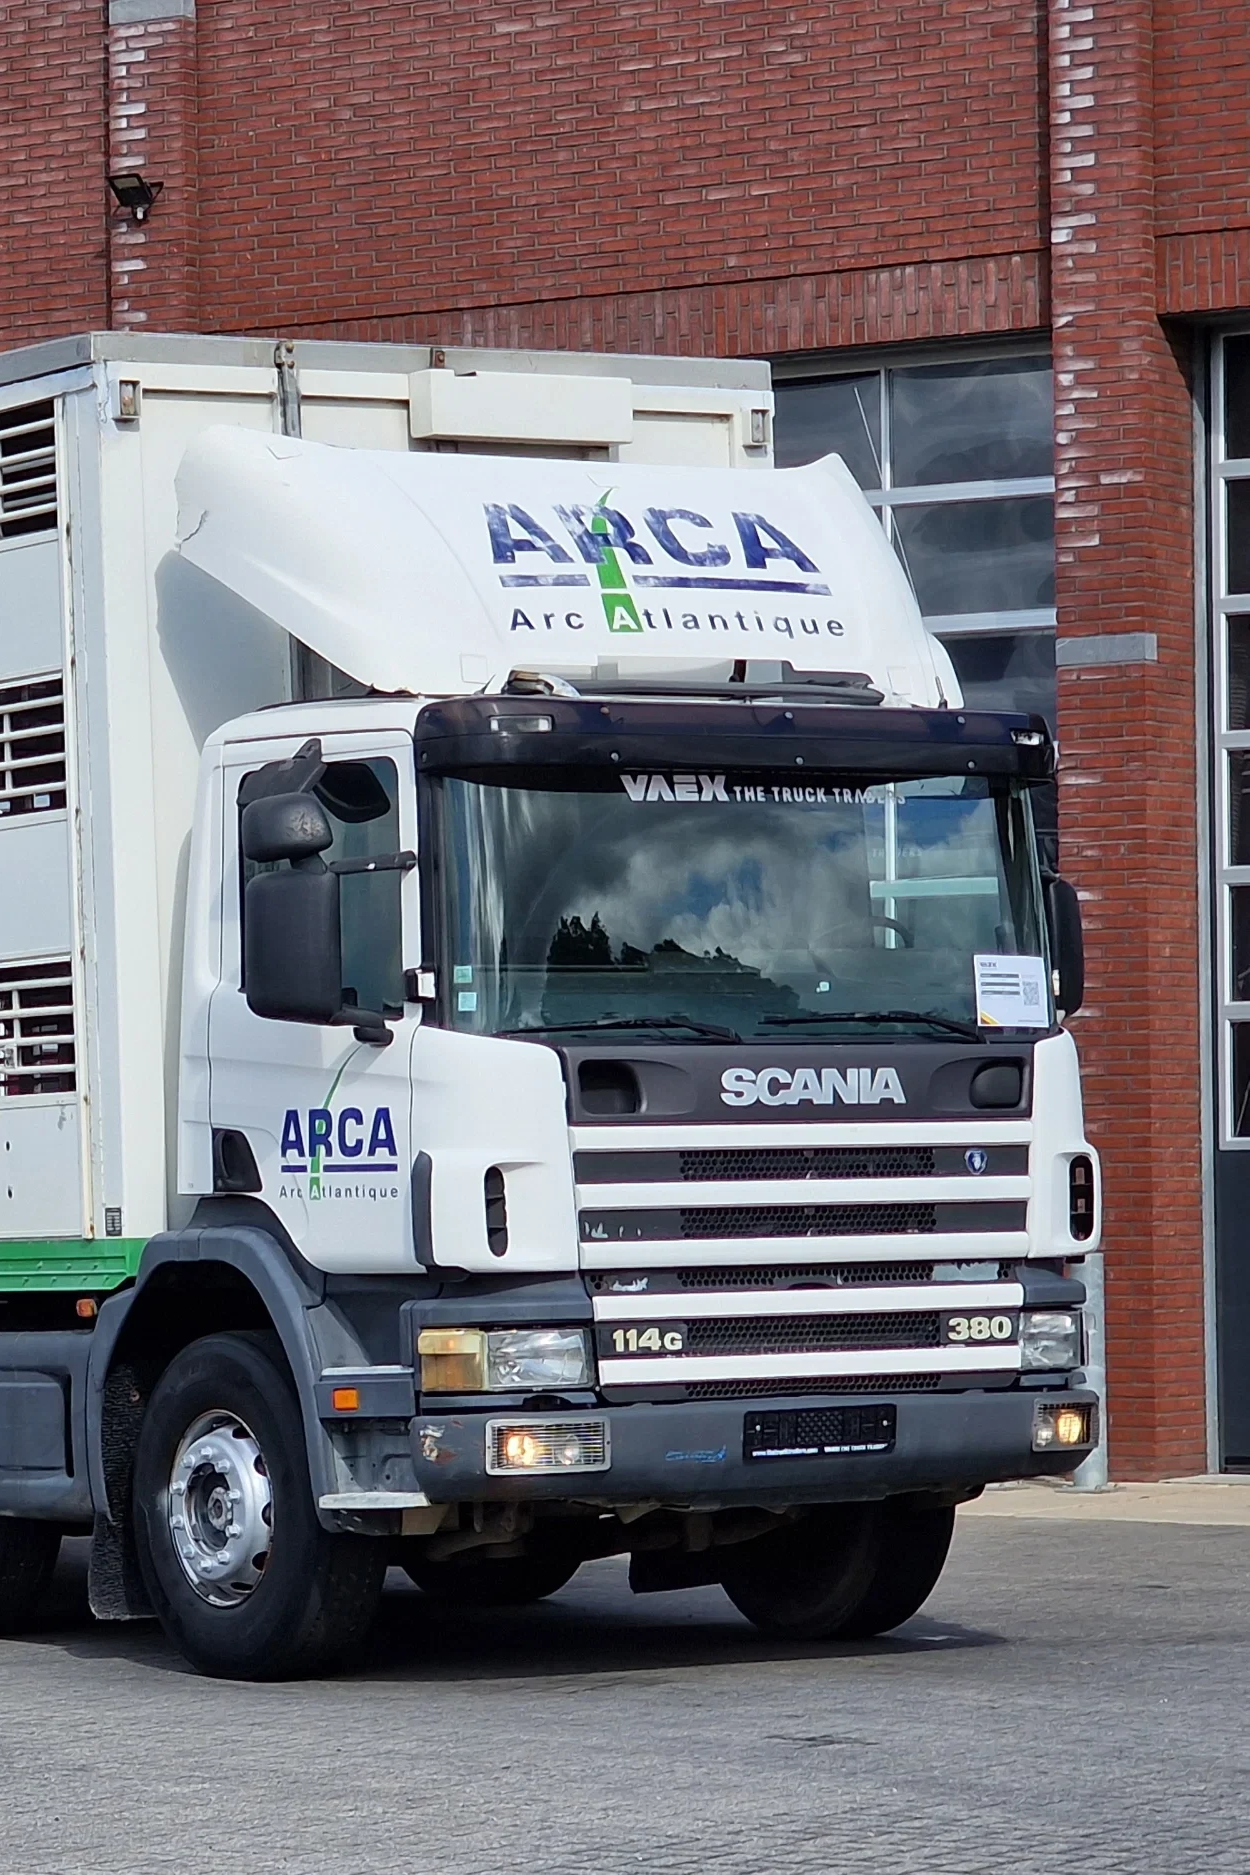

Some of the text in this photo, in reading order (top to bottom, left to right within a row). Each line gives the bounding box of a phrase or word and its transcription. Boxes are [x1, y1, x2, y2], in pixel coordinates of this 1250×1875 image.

[483, 502, 821, 573] ARCA
[510, 605, 846, 639] Arc Atlantique
[619, 774, 906, 804] VAEX THE TRUCK TRADES
[720, 1067, 906, 1106] SCANIA
[281, 1107, 398, 1157] ARCA
[279, 1184, 399, 1201] Arc Atlantique
[612, 1328, 683, 1351] 114G
[947, 1315, 1012, 1340] 380
